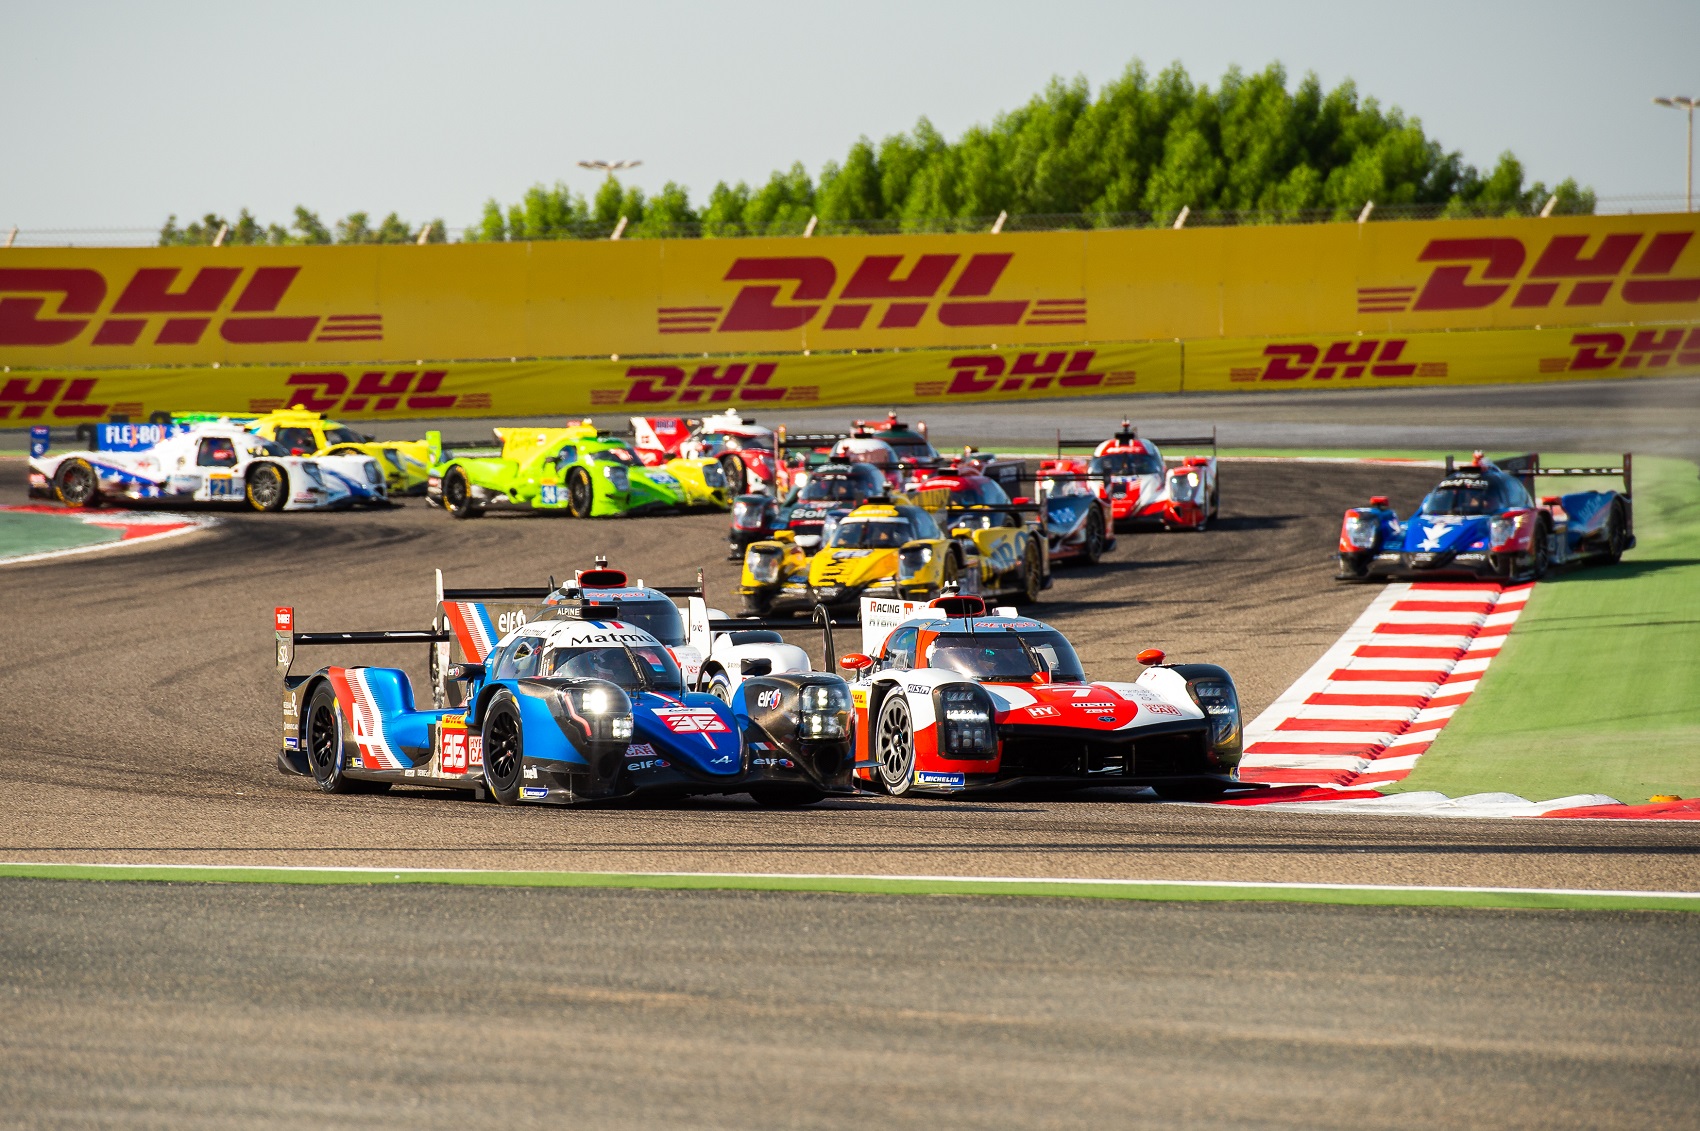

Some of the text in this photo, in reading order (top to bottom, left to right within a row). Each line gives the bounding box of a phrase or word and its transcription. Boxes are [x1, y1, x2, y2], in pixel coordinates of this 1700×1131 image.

[1412, 231, 1700, 311] DHL
[718, 252, 1031, 332] DHL
[0, 267, 318, 345] DHL
[1261, 340, 1418, 381] DHL
[947, 351, 1106, 394] DHL
[285, 371, 459, 412] DHL
[624, 363, 788, 403] DHL
[0, 378, 109, 418] HL
[557, 607, 580, 616] ALPINE
[870, 601, 900, 614] RACING
[570, 632, 656, 647] Matmu
[757, 690, 773, 708] elf
[1028, 707, 1054, 718] HY
[667, 715, 727, 731] 36
[443, 733, 466, 768] 36
[470, 738, 482, 747] HYP
[470, 748, 482, 765] CA
[627, 761, 655, 771] elf
[924, 775, 959, 783] MICHELIN
